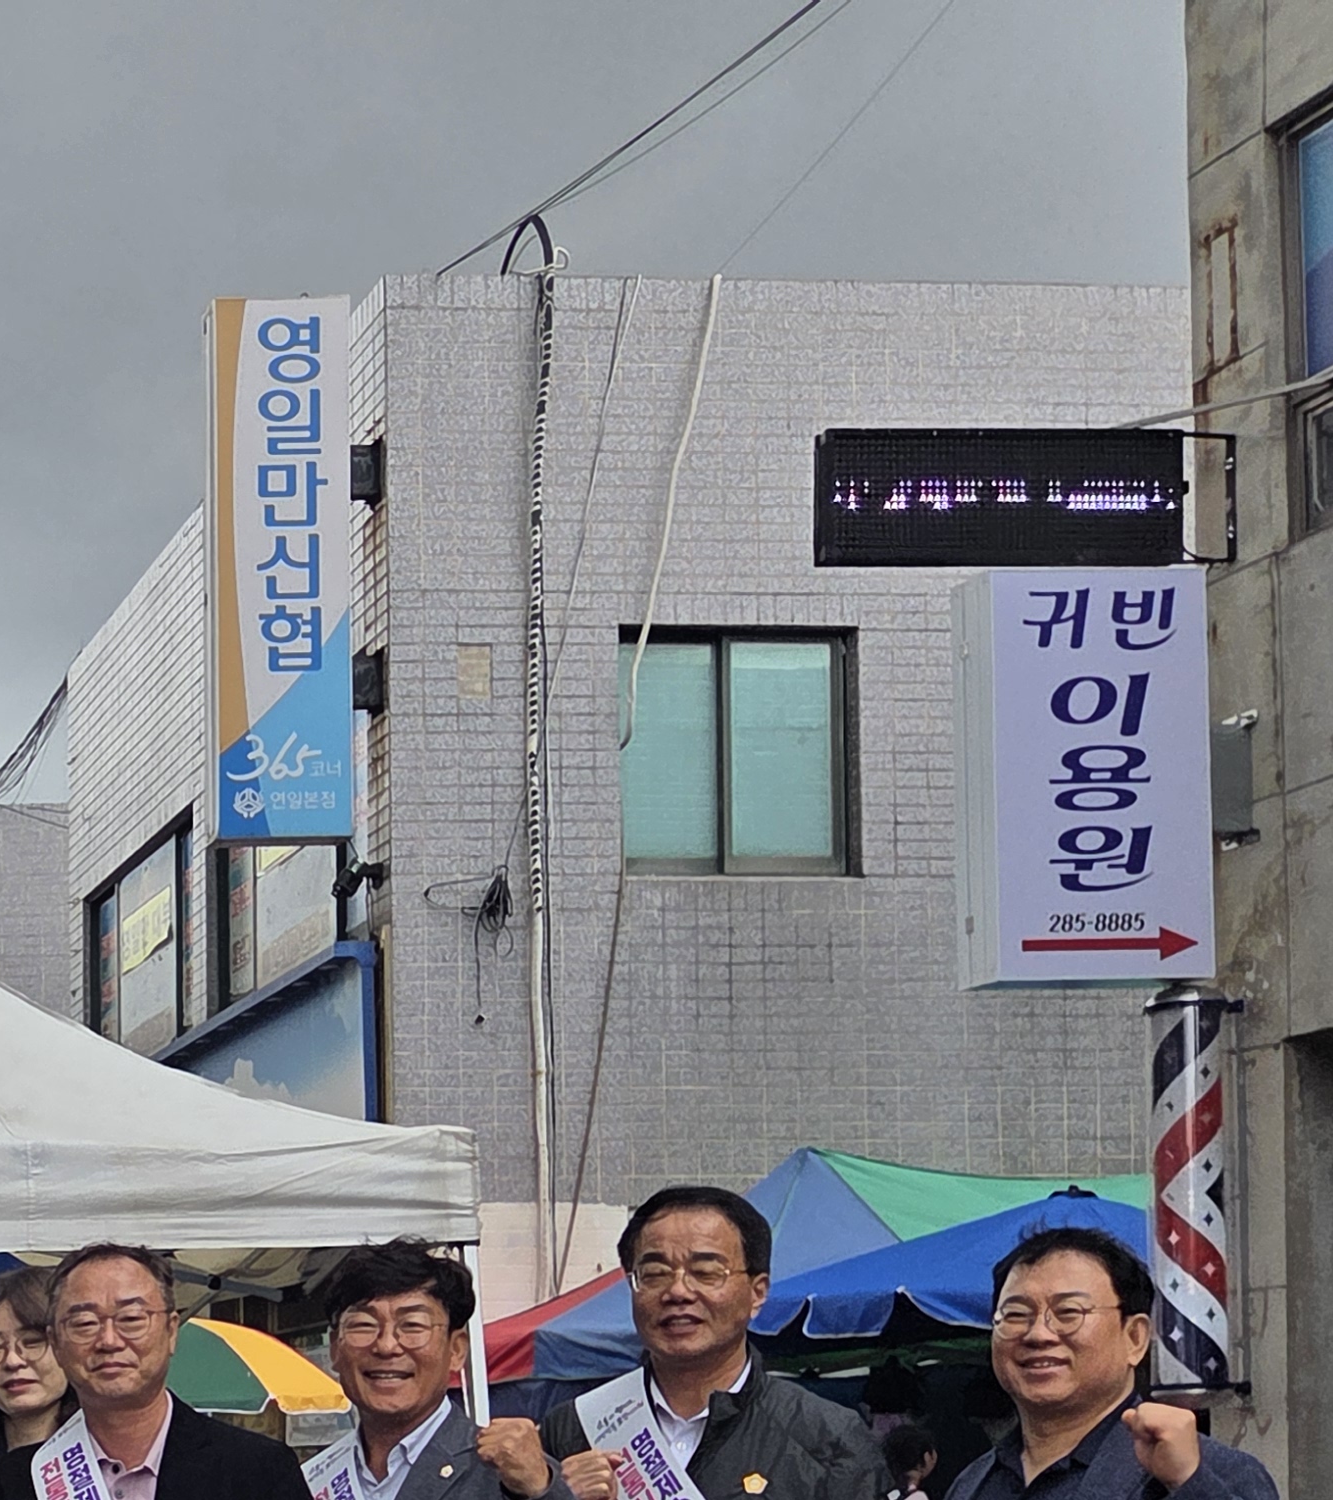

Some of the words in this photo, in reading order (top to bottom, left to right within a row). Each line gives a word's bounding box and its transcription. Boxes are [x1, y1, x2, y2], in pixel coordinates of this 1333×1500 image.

[256, 314, 329, 673] 영일만신협
[1022, 586, 1178, 651] 귀빈
[226, 730, 322, 781] 365
[309, 760, 342, 778] 코너
[1048, 671, 1154, 893] 이용원
[269, 790, 336, 810] 연일본점
[1047, 913, 1146, 934] 285-8885
